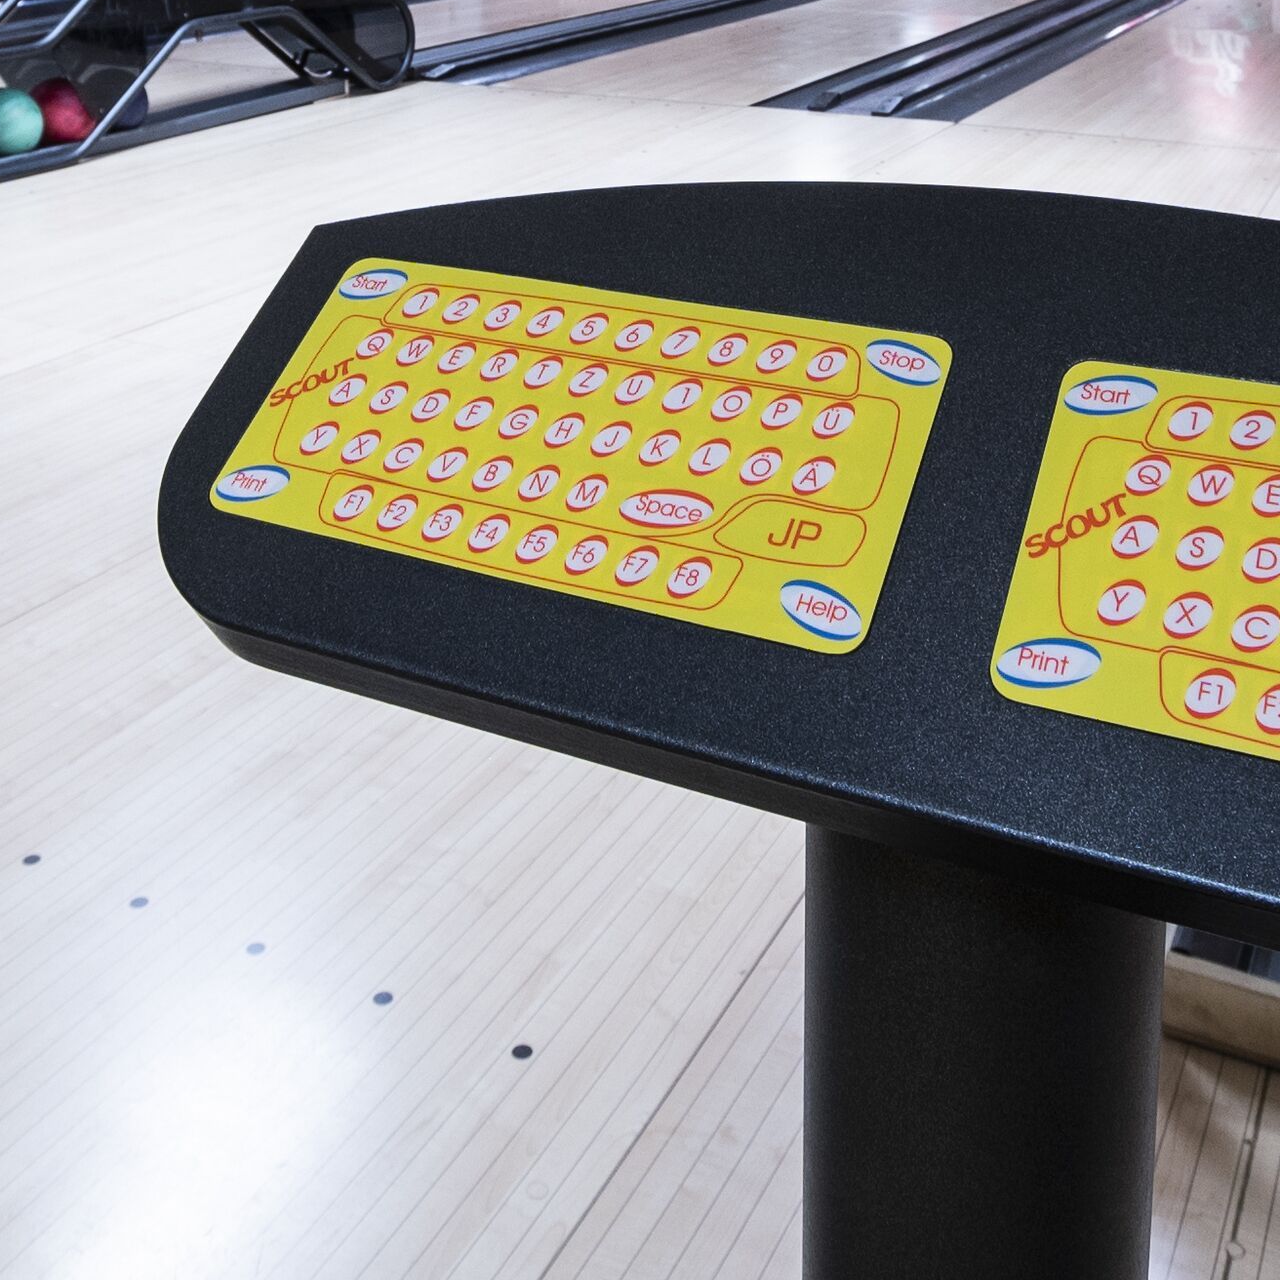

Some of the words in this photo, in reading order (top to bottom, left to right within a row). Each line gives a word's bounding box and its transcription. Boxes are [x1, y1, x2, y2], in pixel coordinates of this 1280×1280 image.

[352, 275, 389, 292] Start
[419, 295, 429, 311] 1
[452, 300, 469, 317] 2
[495, 306, 510, 323] 3
[535, 313, 551, 329] 4
[580, 319, 597, 337] 5
[625, 327, 640, 344] 6
[673, 333, 690, 350] 7
[718, 339, 735, 358] 8
[769, 347, 785, 365] 9
[817, 354, 834, 373] 0
[879, 350, 926, 373] Stop
[270, 358, 355, 408] SCOUT
[366, 335, 387, 354] Q
[407, 342, 429, 359] W
[447, 348, 464, 366] E
[489, 355, 507, 374] R
[537, 362, 550, 381] T
[578, 370, 596, 389] Z
[626, 377, 644, 397] U
[722, 394, 744, 413] O
[772, 401, 789, 420] P
[822, 408, 841, 431] Ü
[1080, 383, 1131, 405] Start
[335, 380, 351, 399] A
[379, 388, 395, 406] S
[421, 395, 440, 414] D
[464, 403, 482, 421] F
[509, 412, 530, 431] G
[554, 420, 574, 440] H
[603, 430, 620, 448] J
[649, 436, 670, 458] K
[701, 446, 712, 467] L
[750, 454, 772, 478] Ö
[799, 463, 820, 488] Ä
[1190, 411, 1199, 431] 1
[1243, 419, 1262, 440] 2
[231, 472, 269, 493] Print
[312, 428, 328, 446] Y
[349, 436, 371, 456] X
[394, 446, 415, 465] C
[441, 454, 459, 473] V
[482, 463, 499, 483] B
[528, 472, 550, 493] N
[574, 480, 600, 504] M
[635, 494, 703, 524] Space
[1137, 464, 1163, 489] Q
[1199, 473, 1228, 497] W
[343, 493, 365, 512] F1
[383, 502, 408, 522] F2
[428, 512, 453, 532] F3
[474, 522, 499, 543] F4
[522, 532, 548, 553] F5
[571, 544, 596, 564] F6
[622, 555, 649, 575] F7
[673, 566, 700, 587] F8
[767, 517, 824, 550] JP
[1024, 493, 1127, 559] SCOUT
[1118, 525, 1140, 548] A
[1189, 536, 1206, 559] S
[1255, 546, 1278, 571] D
[795, 593, 848, 624] Help
[1111, 588, 1130, 613] Y
[1175, 601, 1198, 628] X
[1244, 616, 1271, 641] C
[1018, 647, 1069, 676] Print
[1197, 680, 1224, 706] F1
